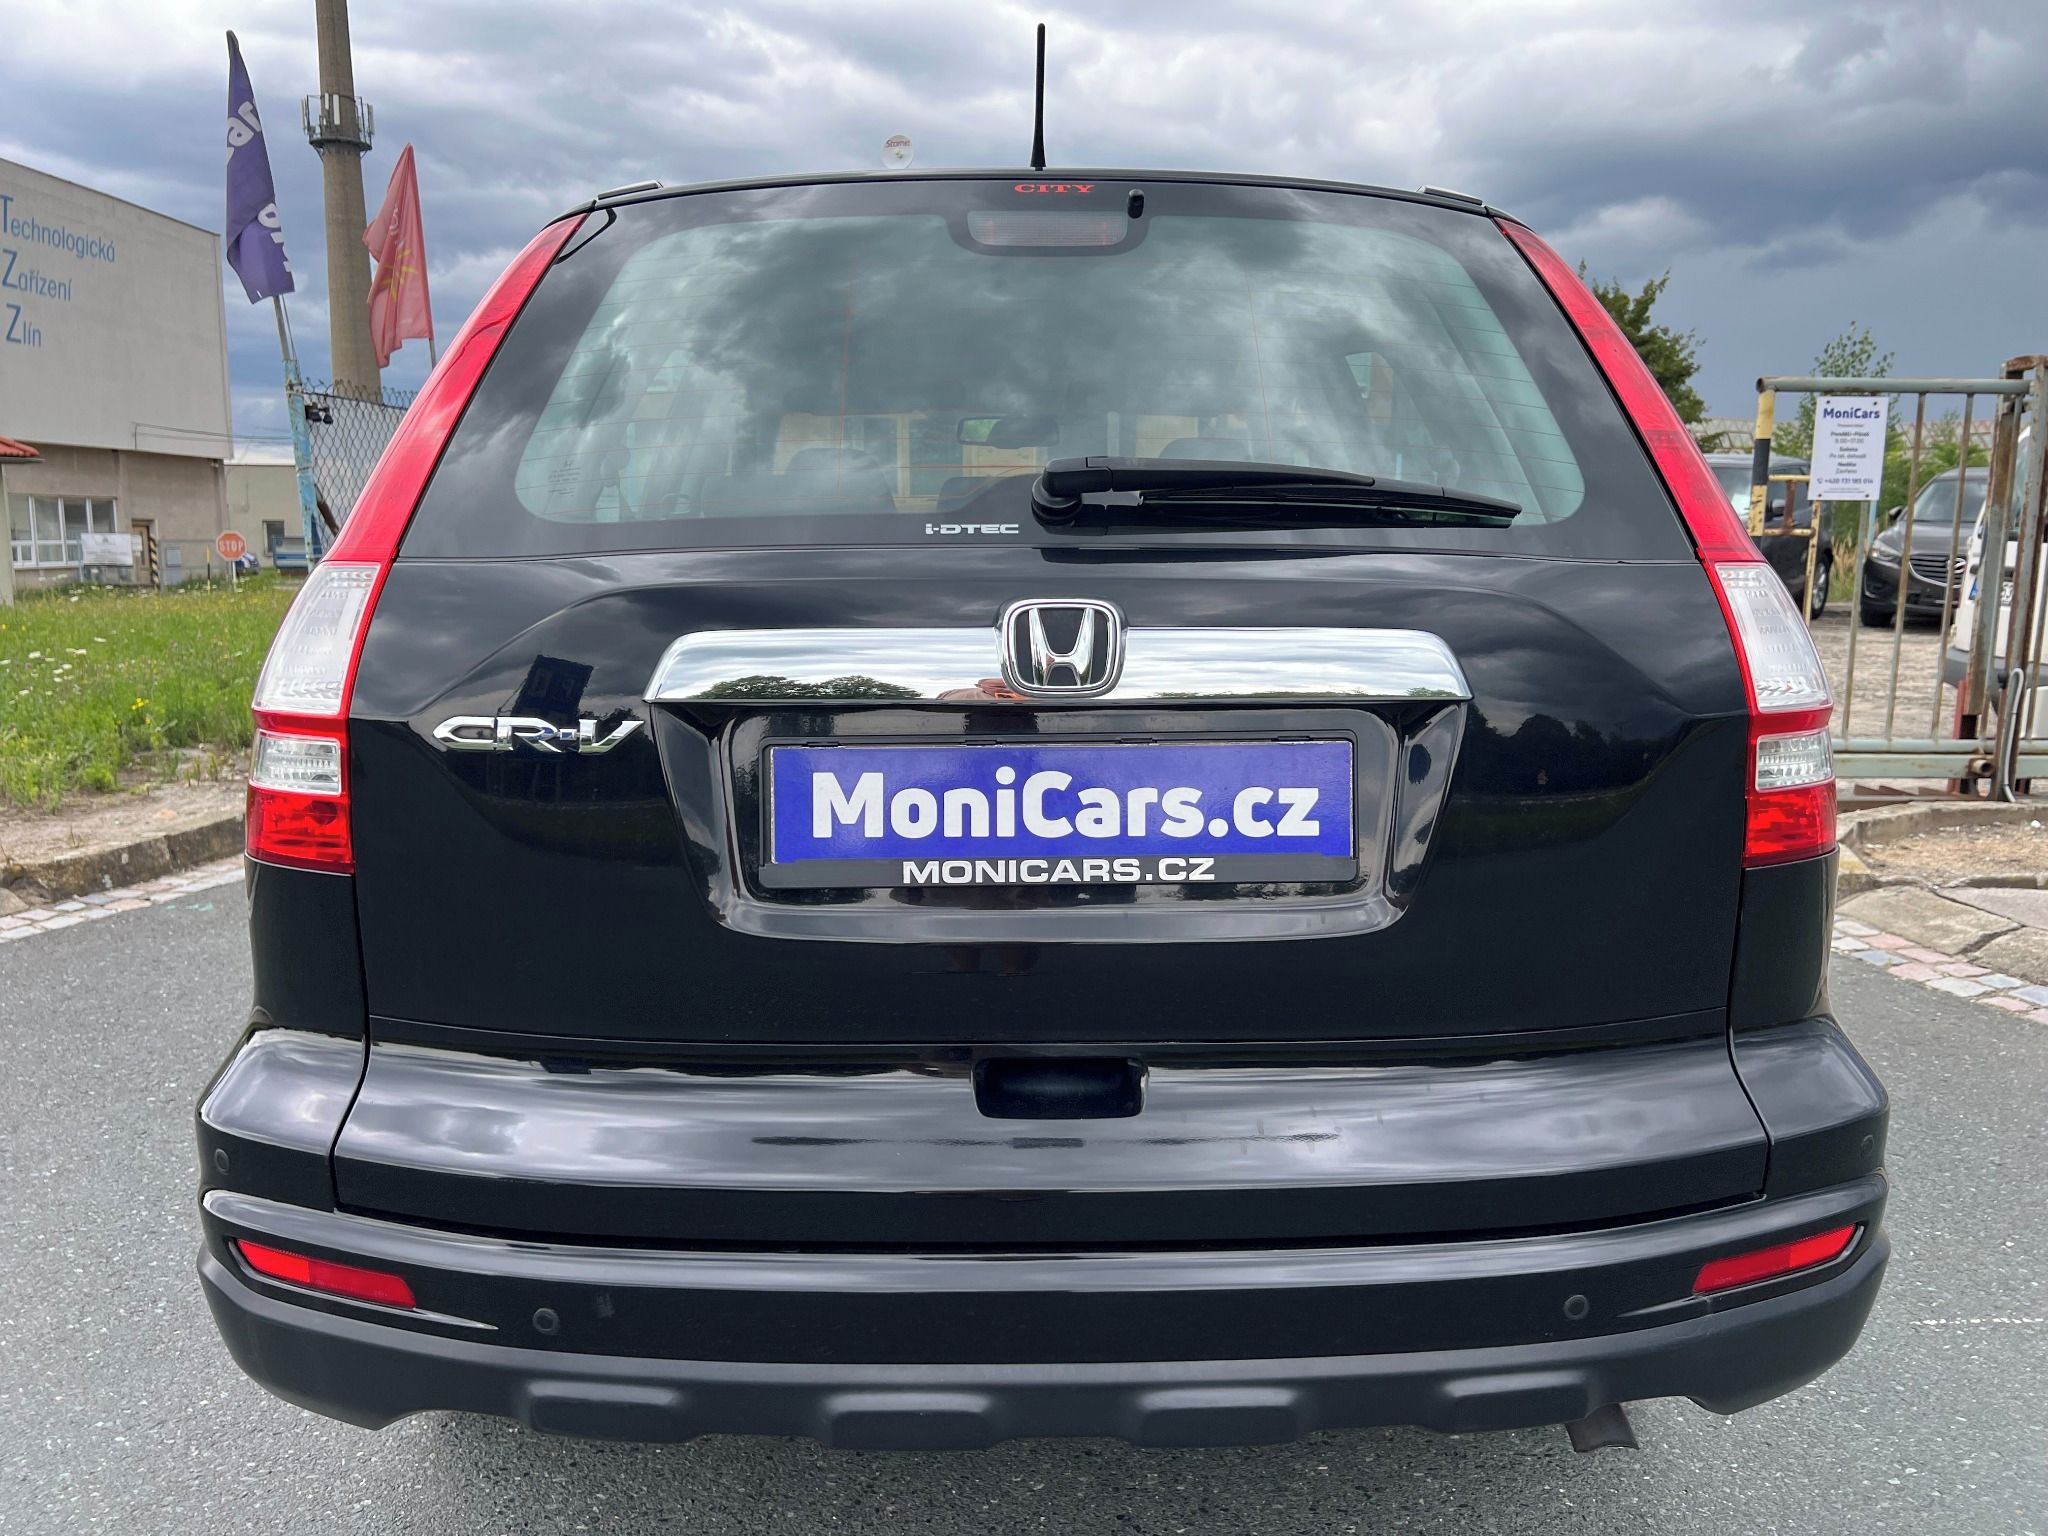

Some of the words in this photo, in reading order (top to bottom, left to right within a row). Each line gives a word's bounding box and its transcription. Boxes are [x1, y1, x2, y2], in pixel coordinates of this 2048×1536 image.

[1014, 184, 1094, 193] CITY
[0, 194, 116, 263] Technologická
[2, 249, 73, 301] Zařízení
[6, 303, 42, 348] Zlín
[1823, 407, 1880, 419] MoniCars
[219, 540, 243, 552] STOP
[432, 715, 645, 754] CR-V
[812, 765, 1320, 839] MoniCars.cz
[903, 857, 1216, 884] MONICARS.CZ
